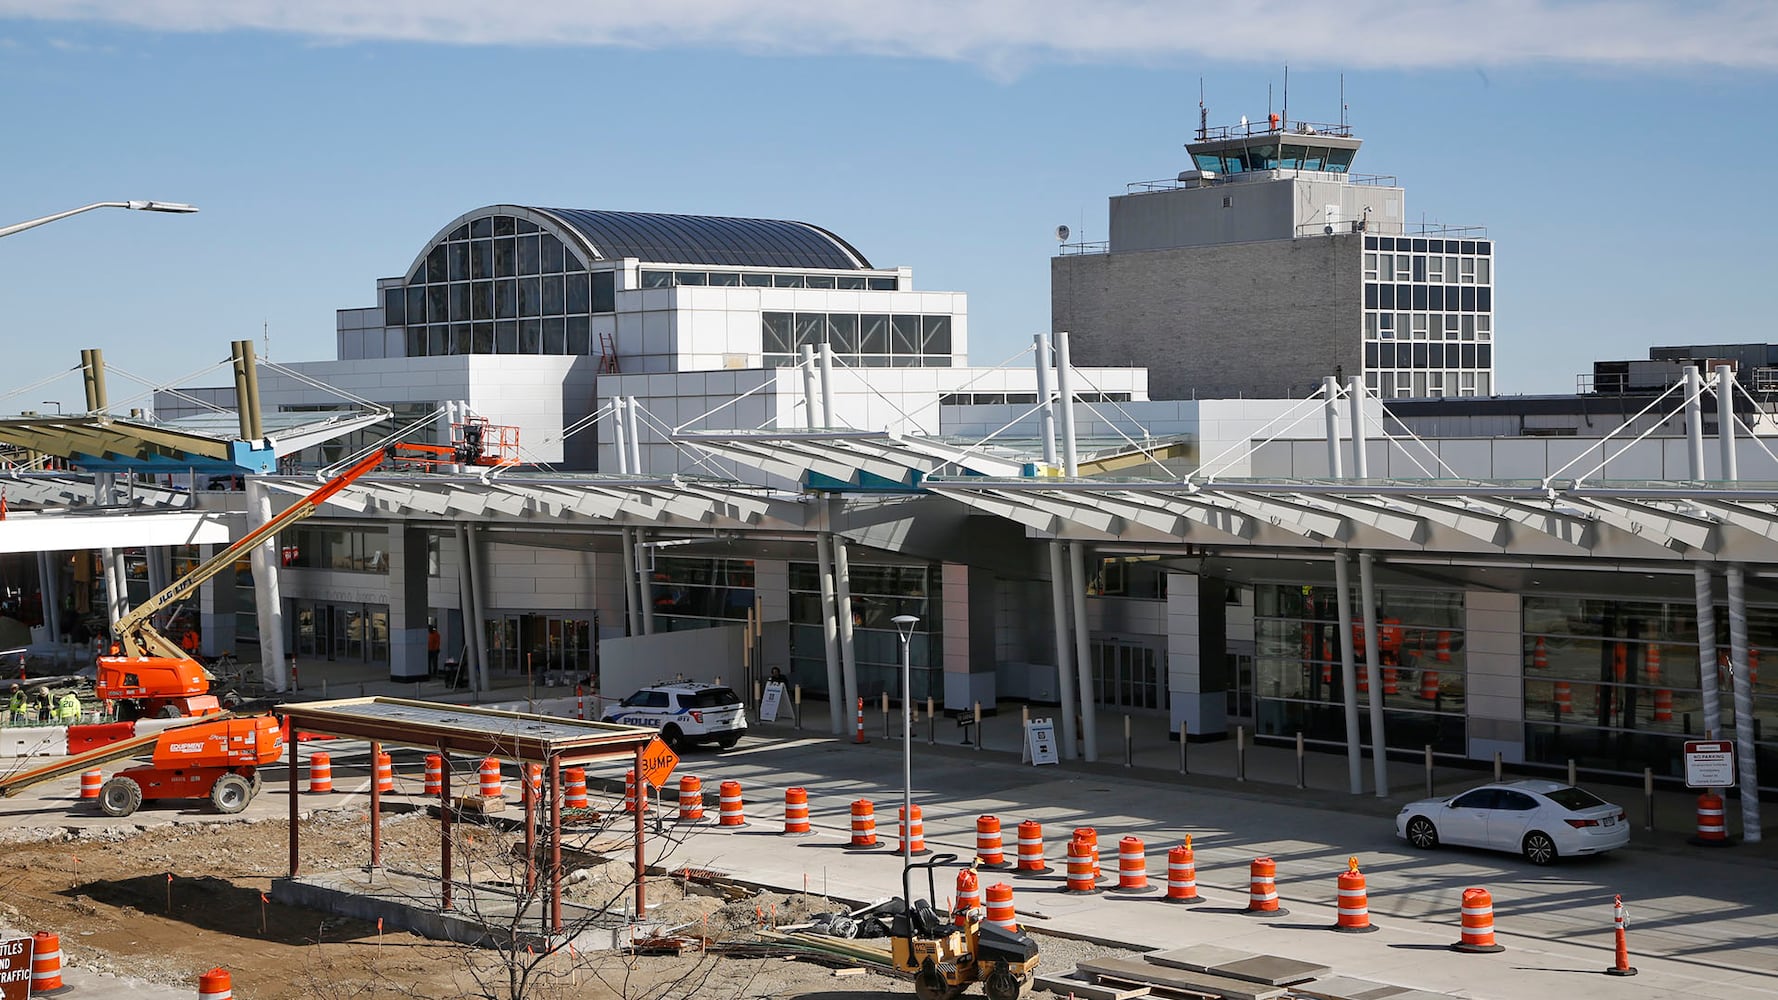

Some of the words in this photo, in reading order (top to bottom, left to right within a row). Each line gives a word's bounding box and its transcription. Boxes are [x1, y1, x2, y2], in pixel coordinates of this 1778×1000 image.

[158, 590, 173, 605] JLG
[175, 578, 193, 594] LIFT
[63, 700, 74, 708] 20
[623, 717, 661, 728] POLICE
[0, 968, 30, 983] RAFFIC
